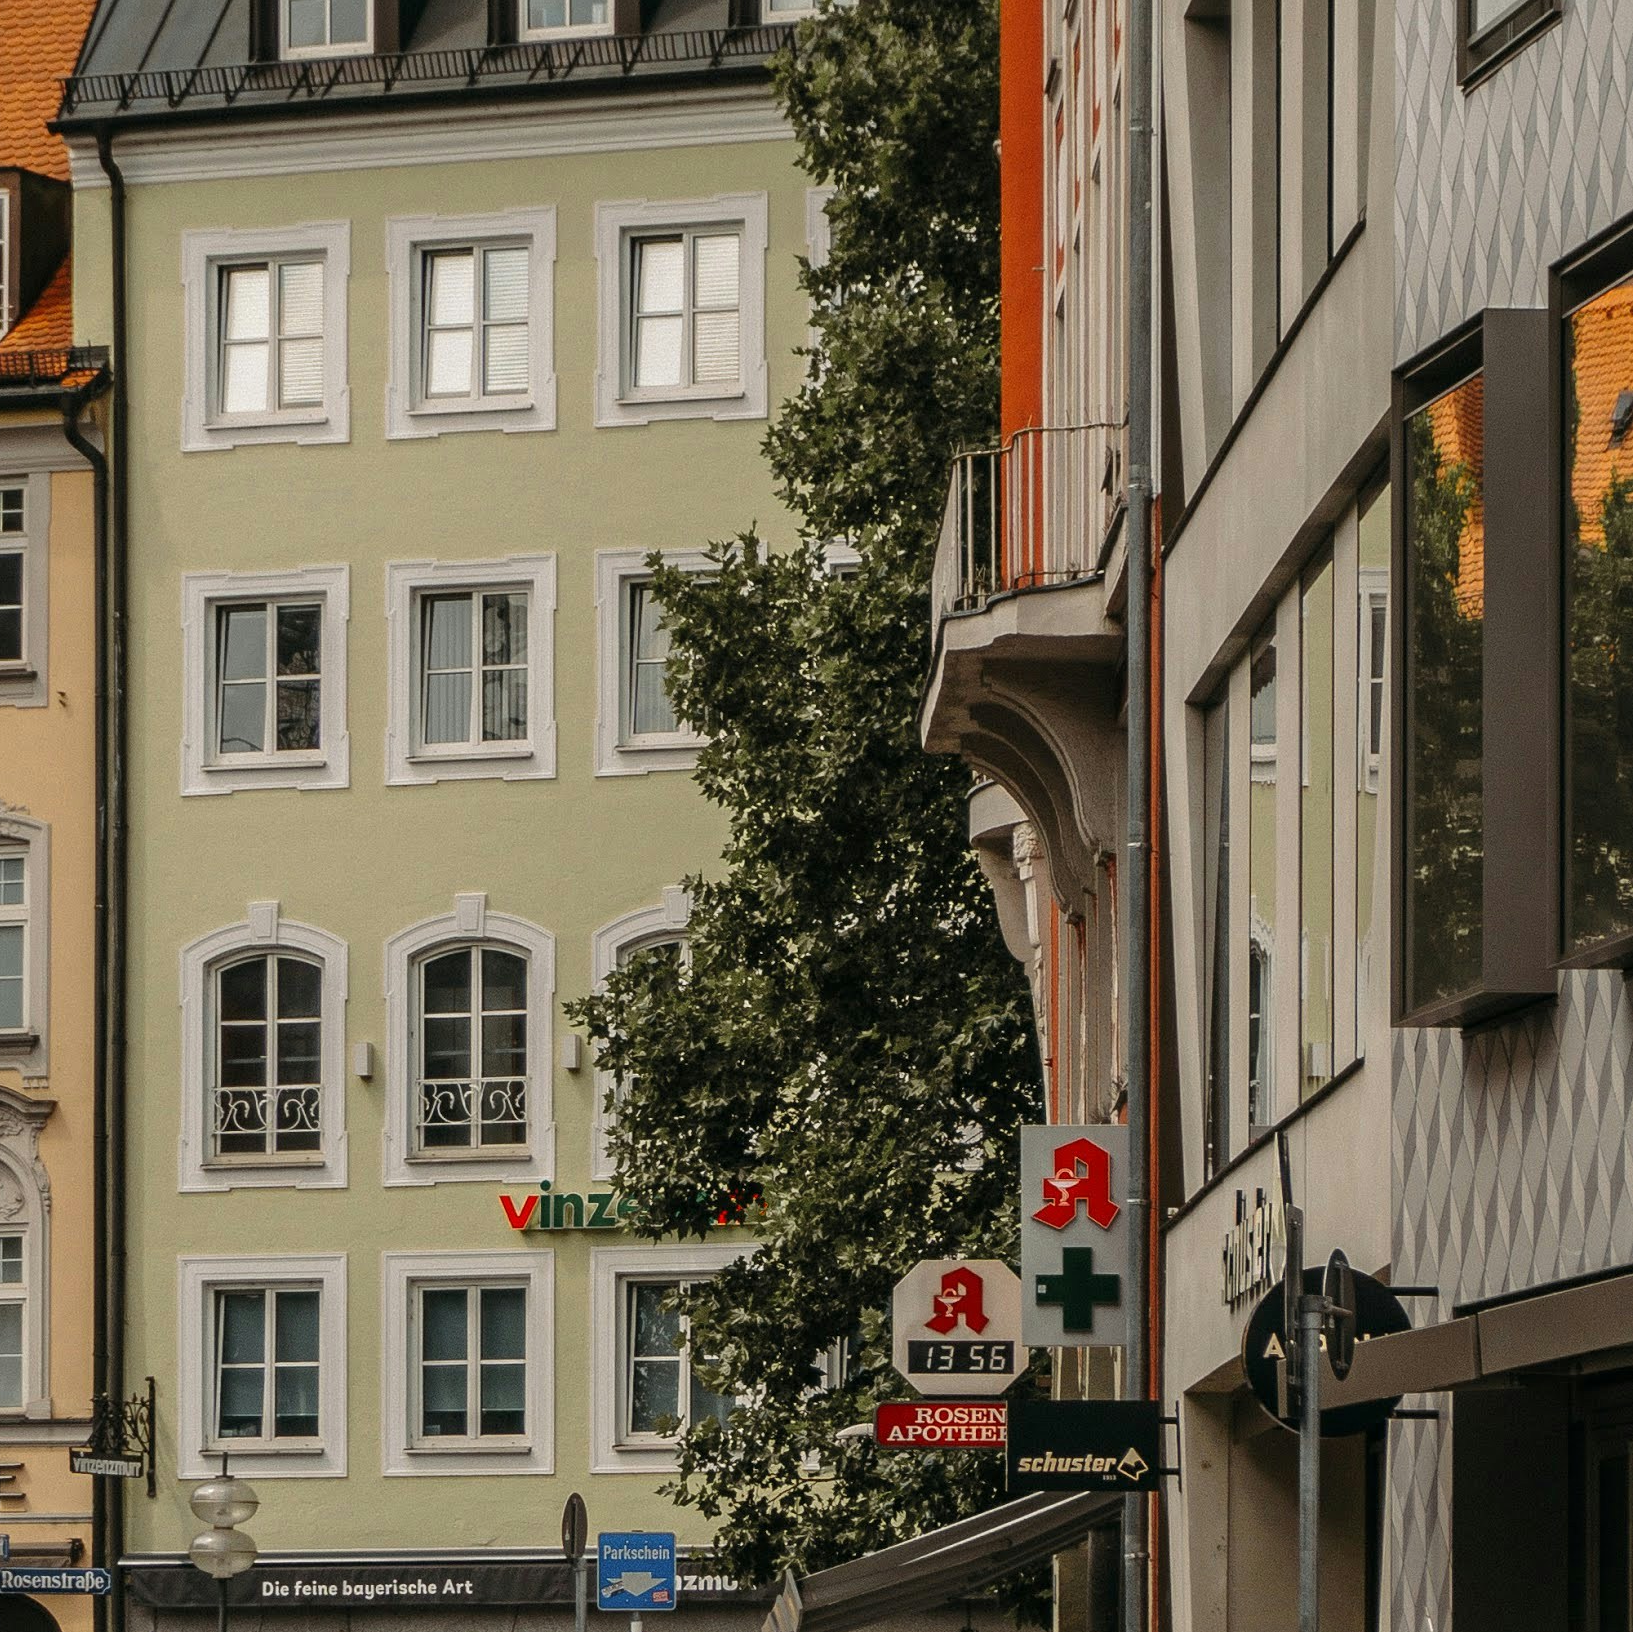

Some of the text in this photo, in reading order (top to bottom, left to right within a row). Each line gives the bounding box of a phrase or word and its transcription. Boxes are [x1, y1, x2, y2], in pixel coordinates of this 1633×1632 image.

[915, 1407, 1007, 1425] ROSEN
[1018, 1451, 1117, 1473] schuster
[603, 1544, 670, 1560] Parkschein
[1, 1570, 105, 1592] Rosenstraße
[262, 1578, 474, 1600] Die feine bayerische Art
